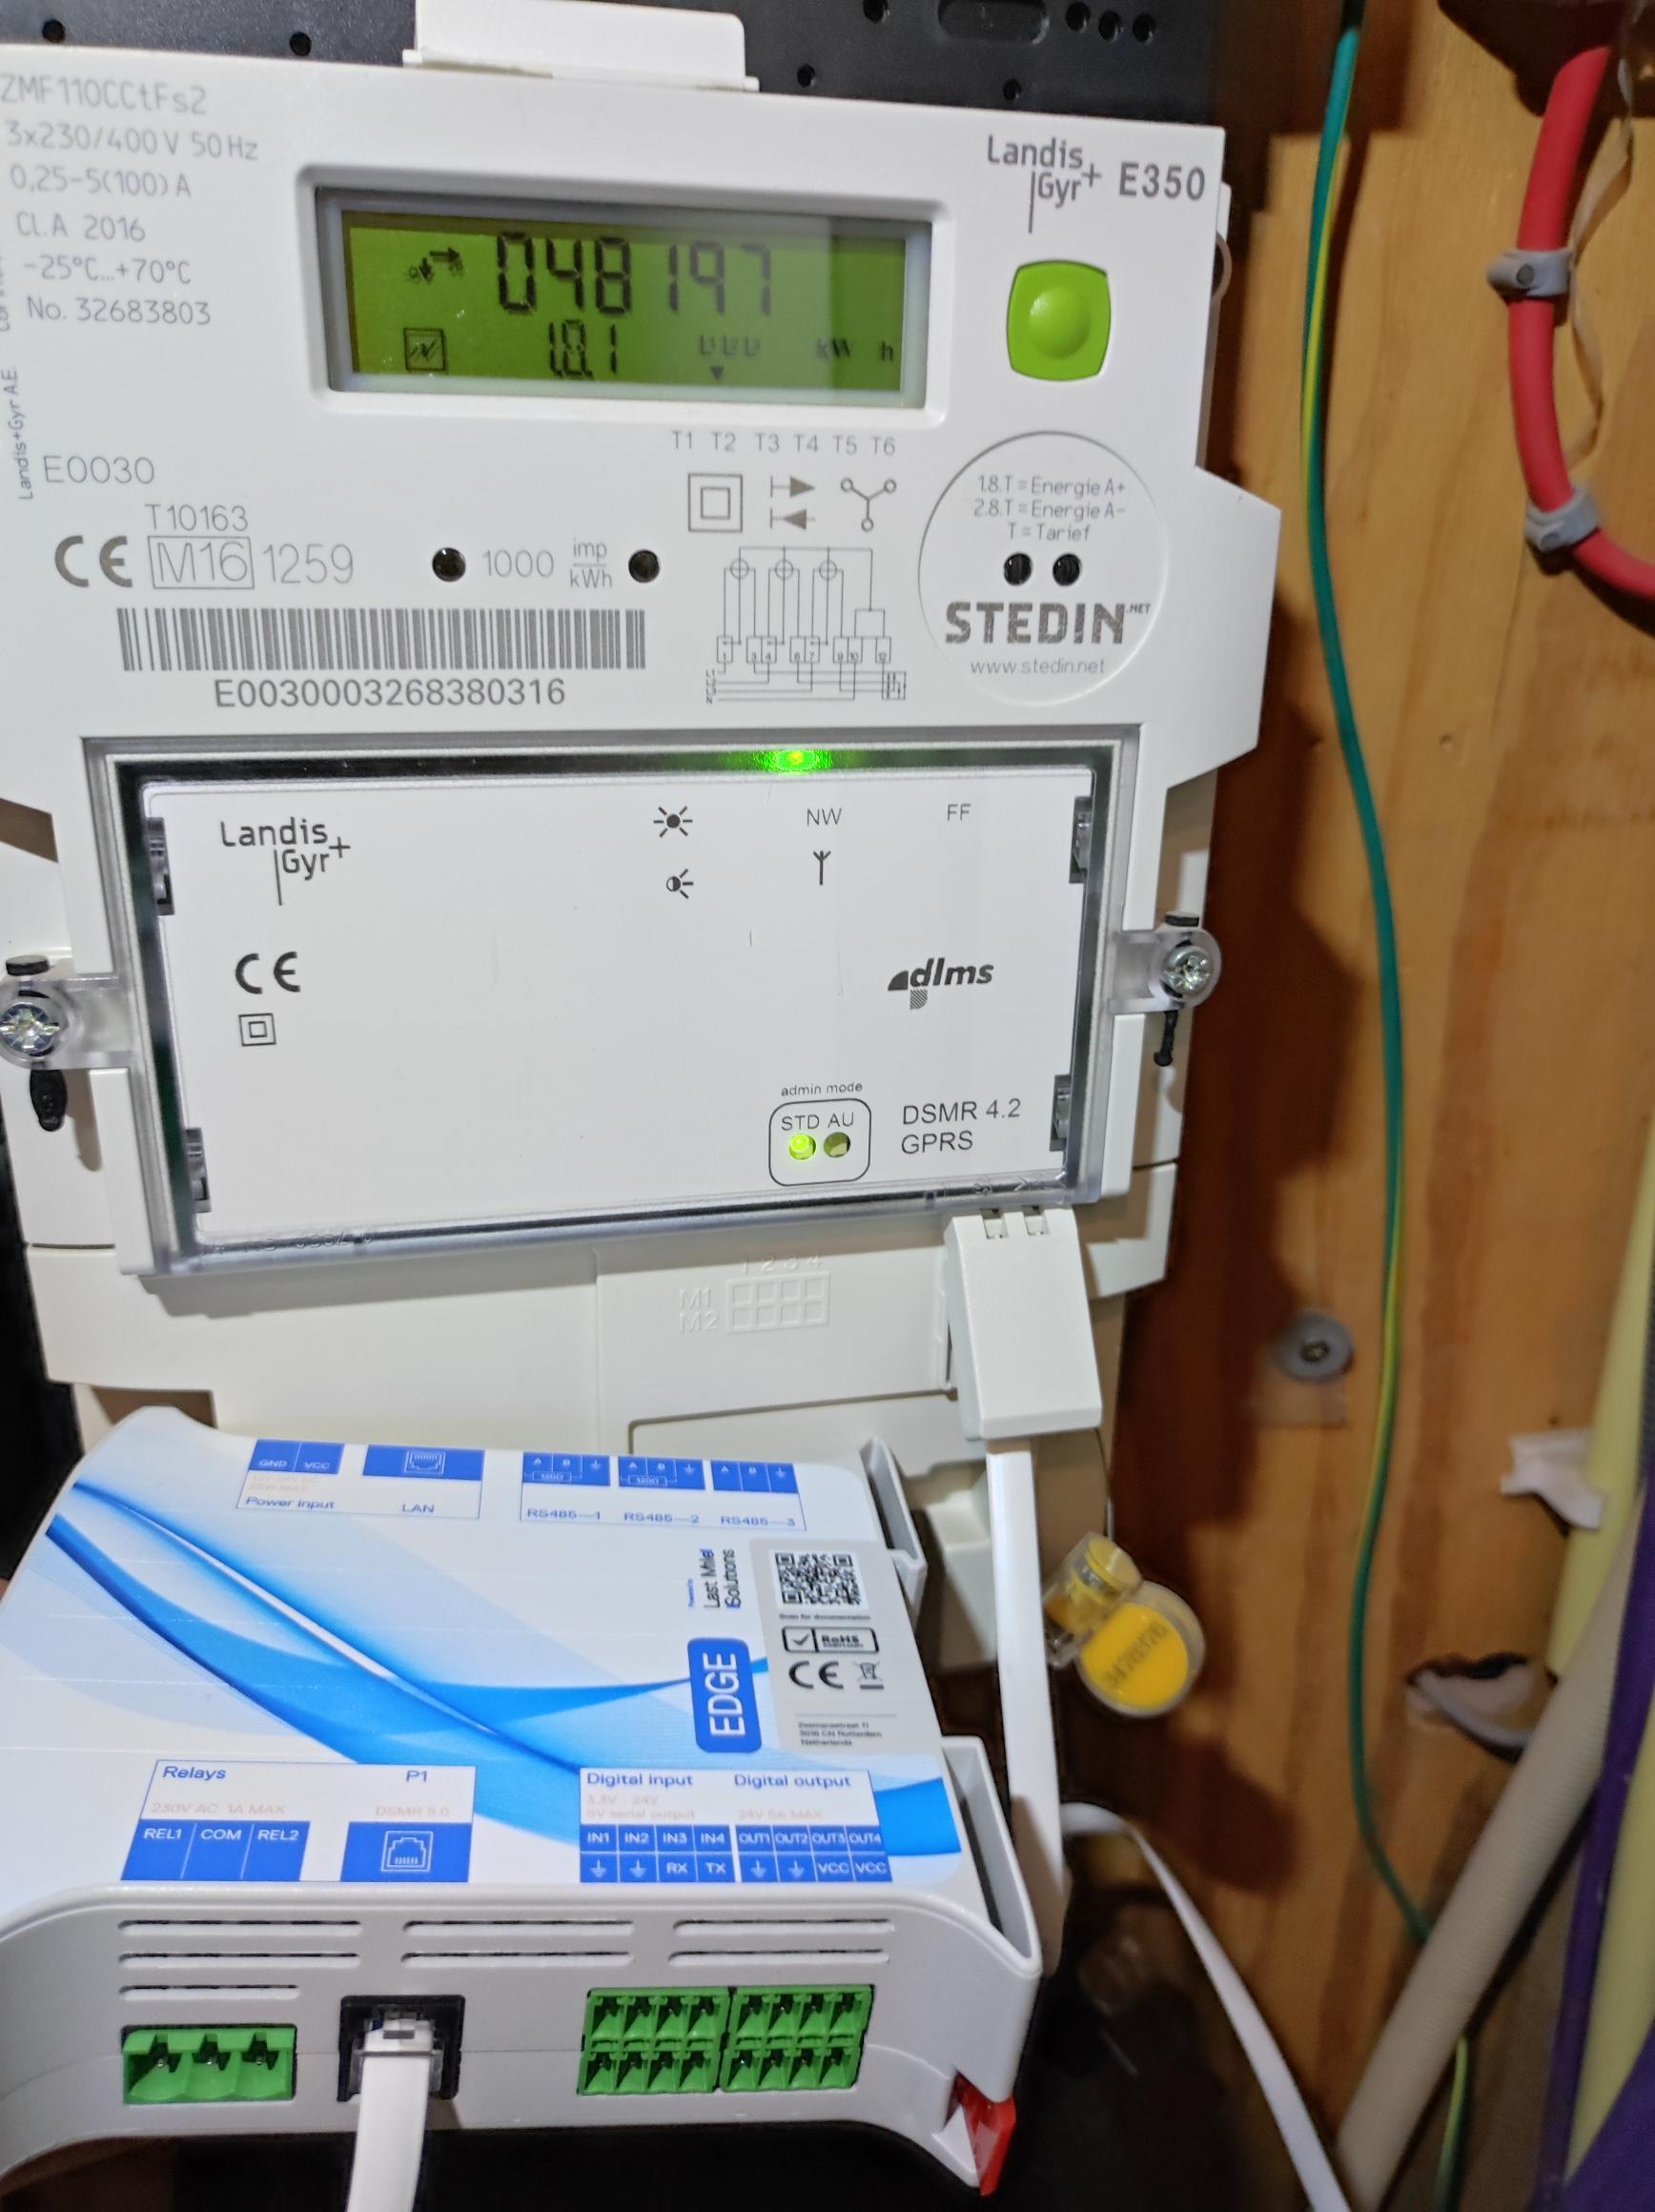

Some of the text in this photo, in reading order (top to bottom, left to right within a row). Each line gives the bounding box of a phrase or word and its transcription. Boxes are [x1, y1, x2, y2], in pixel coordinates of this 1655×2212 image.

[5, 119, 157, 154] 3x230/400
[988, 134, 1083, 170] Landis
[1118, 161, 1205, 200] E350
[83, 215, 145, 242] 2016
[498, 232, 771, 316] 048197
[76, 297, 212, 326] 32683803
[671, 430, 896, 456] T1 T2 T3 T4 T5 T6
[44, 455, 154, 484] E0030
[1031, 477, 1100, 498] Energie
[145, 503, 248, 531] T10163
[1031, 501, 1099, 522] Energie
[1037, 524, 1091, 542] Tarief
[263, 543, 354, 584] 1259
[482, 549, 555, 578] 1000
[570, 569, 612, 588] kWh
[945, 602, 1125, 645] STEDIN
[971, 658, 1105, 674] www.stedin.net
[215, 678, 565, 707] E0030003268380316
[807, 808, 842, 827] NW
[947, 804, 971, 821] FF
[221, 816, 328, 847] Landis
[909, 957, 993, 988] dlms
[781, 1081, 863, 1096] admin mode
[781, 1112, 854, 1131] STD AU
[903, 1098, 1021, 1125] DSMR 4.2
[901, 1130, 973, 1155] GPRS
[246, 1496, 336, 1509] Power input
[401, 1503, 435, 1513] LAN
[703, 1652, 746, 1735] EDGE
[162, 1766, 226, 1780] Relays
[406, 1771, 428, 1782] P1
[587, 1772, 693, 1788] Digital input
[734, 1773, 851, 1788] Digital output
[144, 1828, 299, 1841] REL1 COM REL2
[587, 1832, 725, 1844] IN1 IN2 IN3 IN4
[739, 1832, 770, 1844] OUT1
[666, 1862, 726, 1874] RX TX
[817, 1862, 887, 1874] VCC VCC
